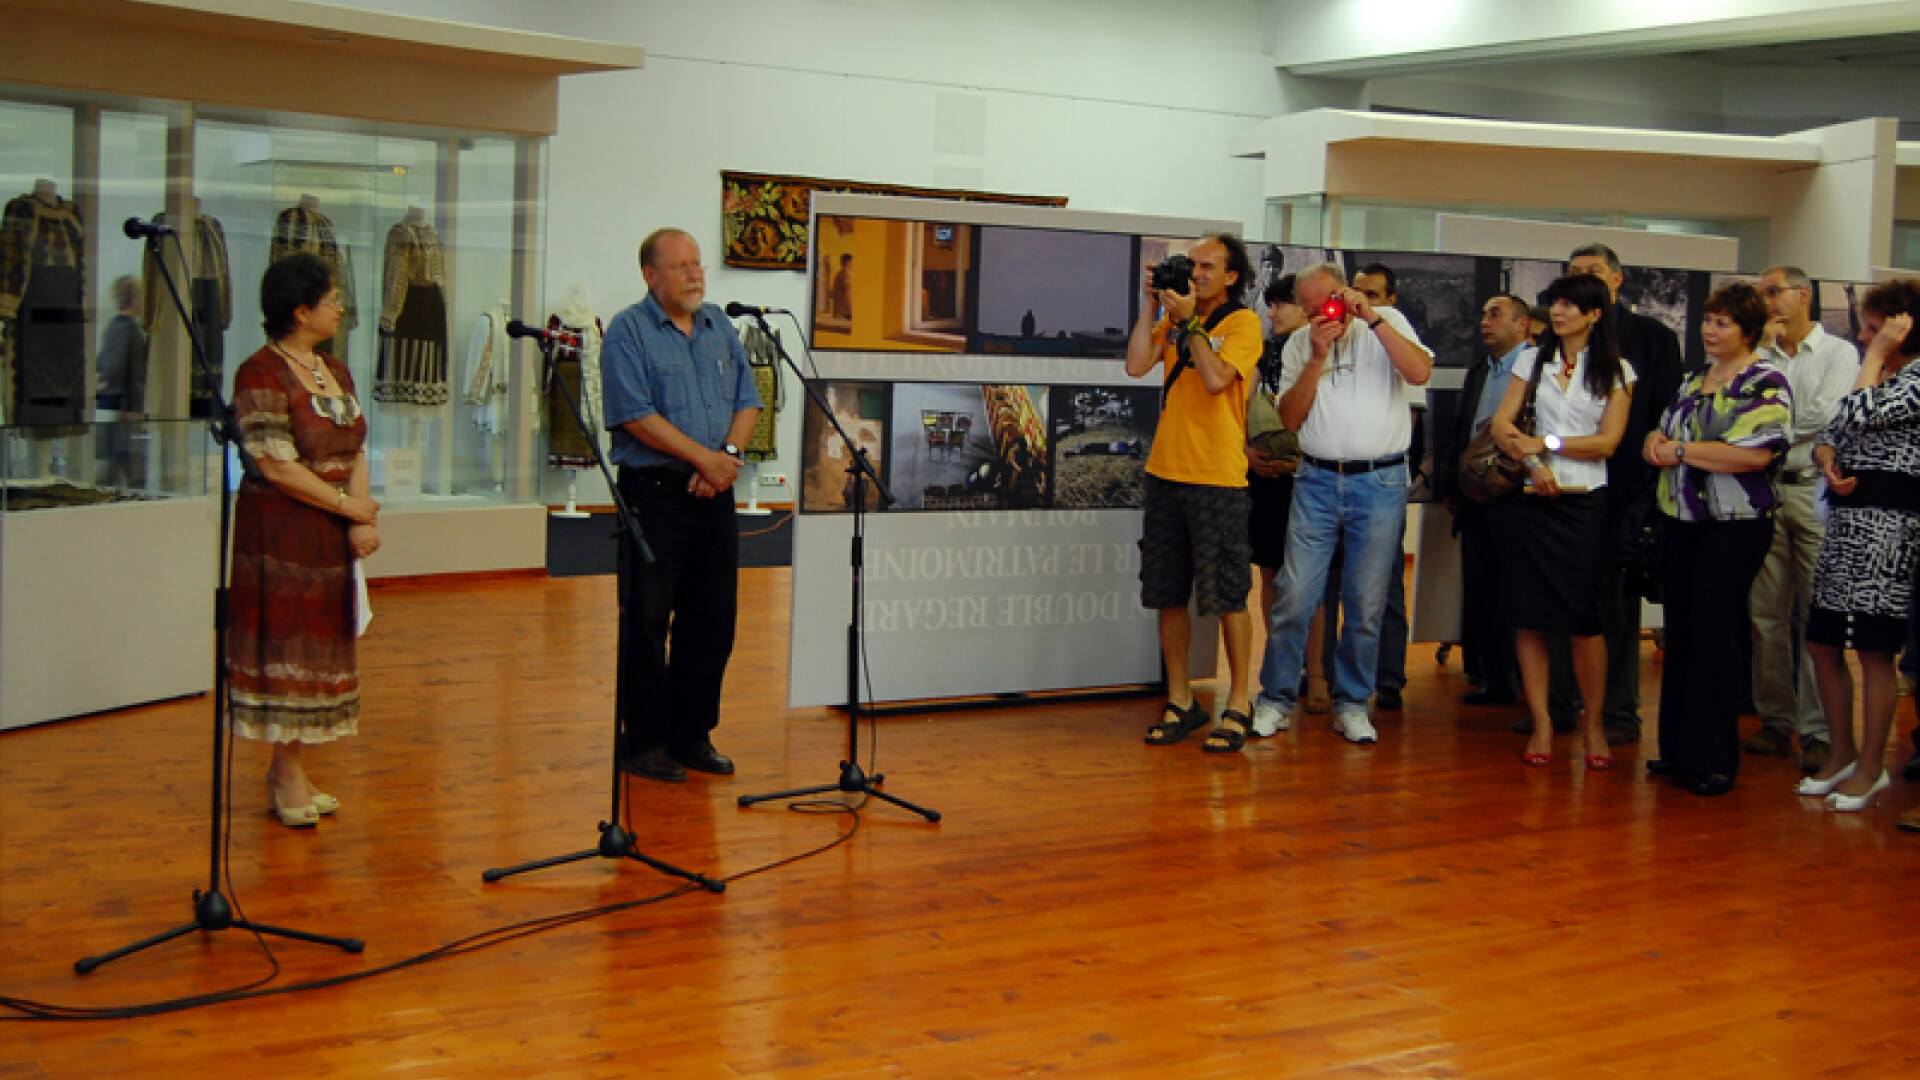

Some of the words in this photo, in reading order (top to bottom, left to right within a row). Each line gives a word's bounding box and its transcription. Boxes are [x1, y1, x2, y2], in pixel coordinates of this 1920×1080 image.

[864, 545, 1061, 580] PATRIMOINE
[1070, 544, 1104, 575] LE
[997, 592, 1122, 626] DOUBLE
